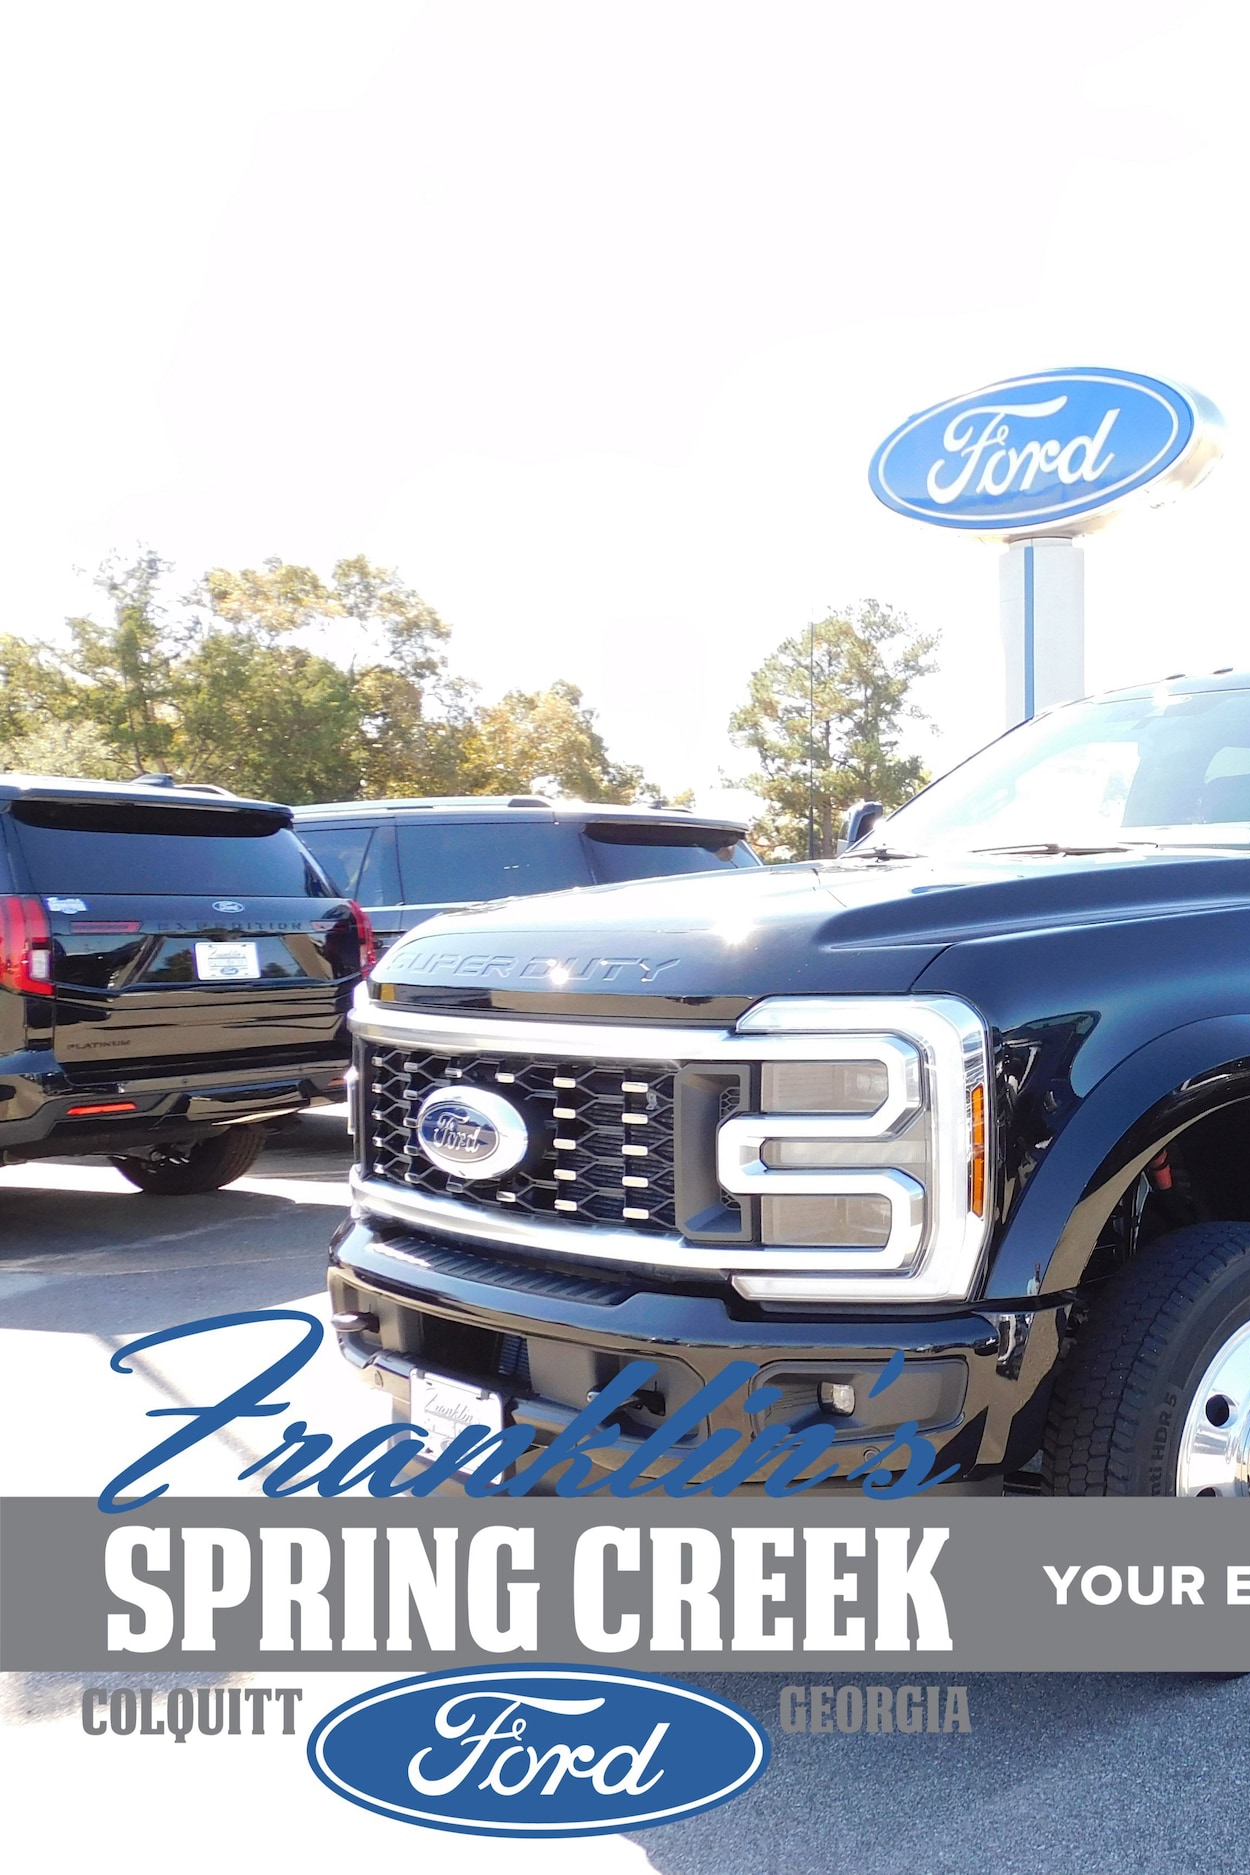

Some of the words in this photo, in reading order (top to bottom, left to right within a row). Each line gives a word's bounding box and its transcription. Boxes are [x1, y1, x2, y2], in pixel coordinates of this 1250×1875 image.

[927, 396, 1120, 504] Ford
[387, 952, 520, 978] SUPER
[520, 956, 680, 982] DUTY
[67, 1040, 131, 1050] PLATINUM
[433, 1111, 481, 1153] Ford
